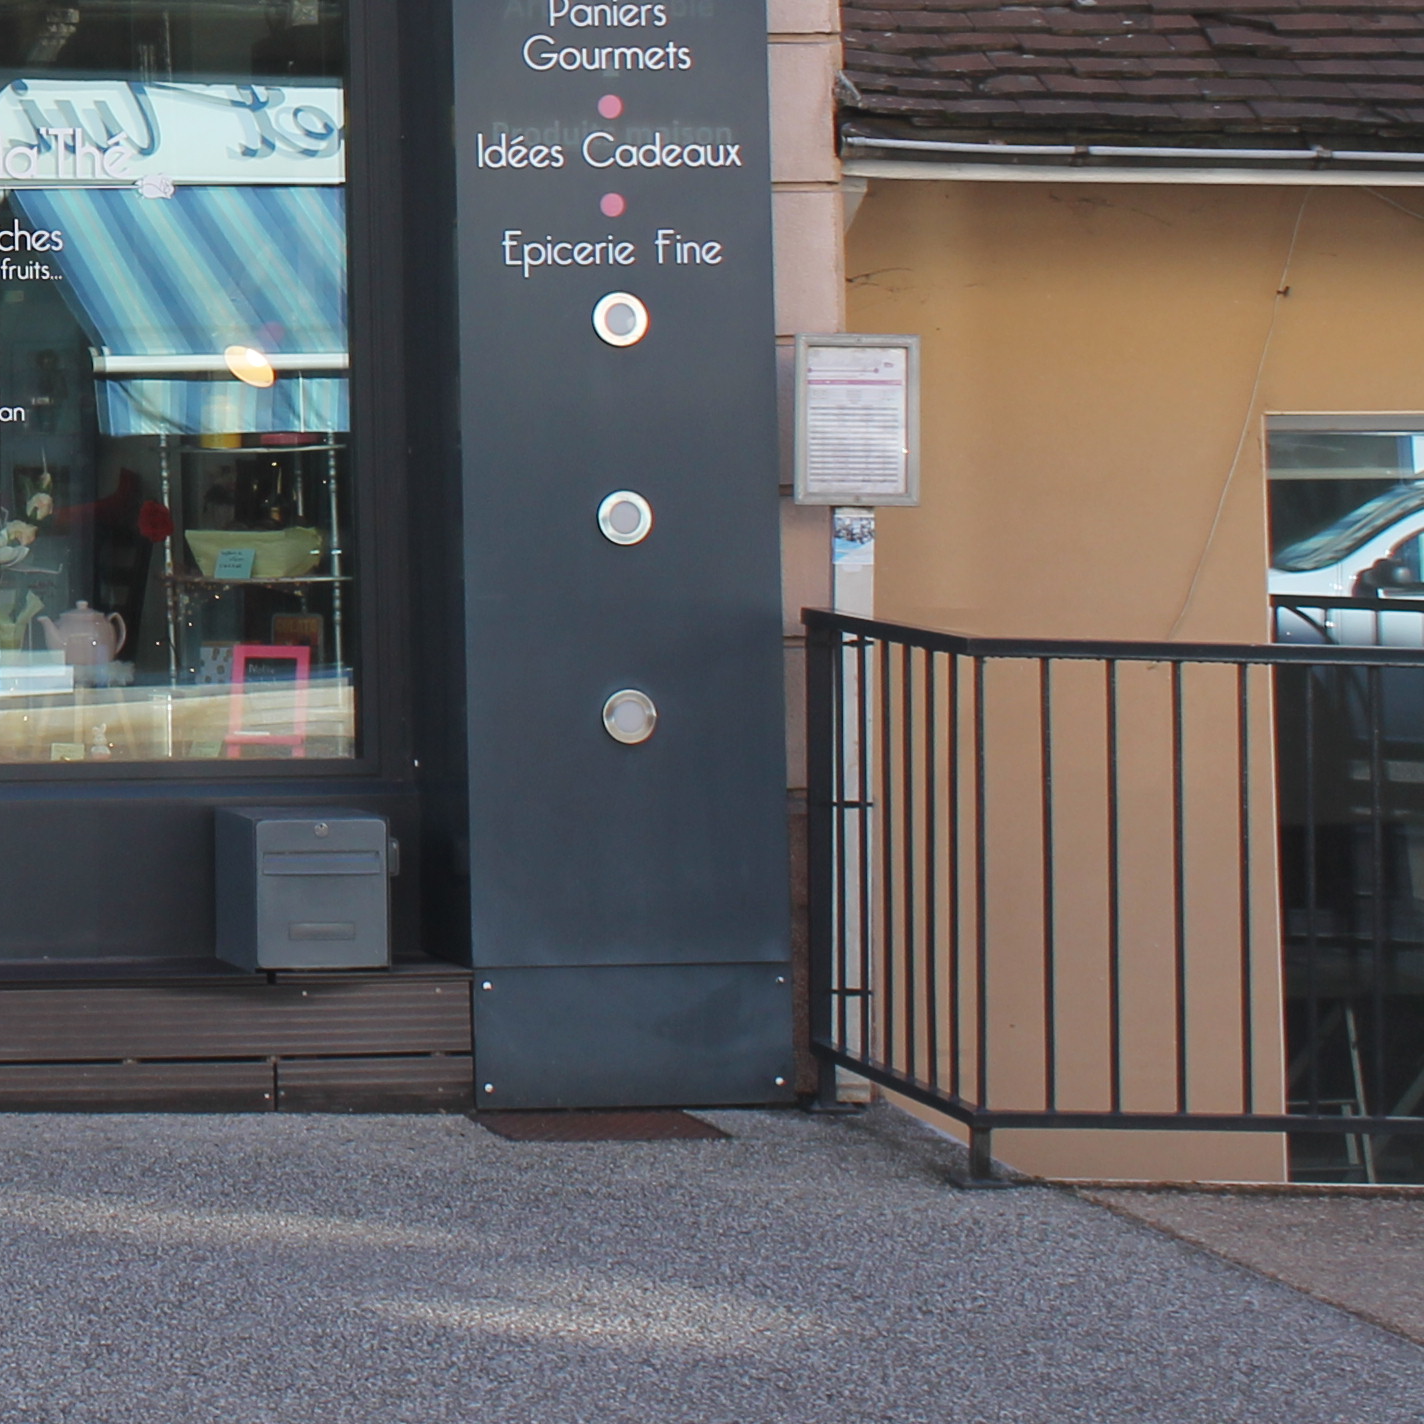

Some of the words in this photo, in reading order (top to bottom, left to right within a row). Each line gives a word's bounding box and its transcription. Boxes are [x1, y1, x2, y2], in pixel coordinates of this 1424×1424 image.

[522, 35, 692, 71] Gourmets
[477, 133, 564, 168] Idées
[582, 132, 742, 168] Cadeaux
[502, 229, 636, 278] Epicerie
[654, 229, 722, 265] Fine
